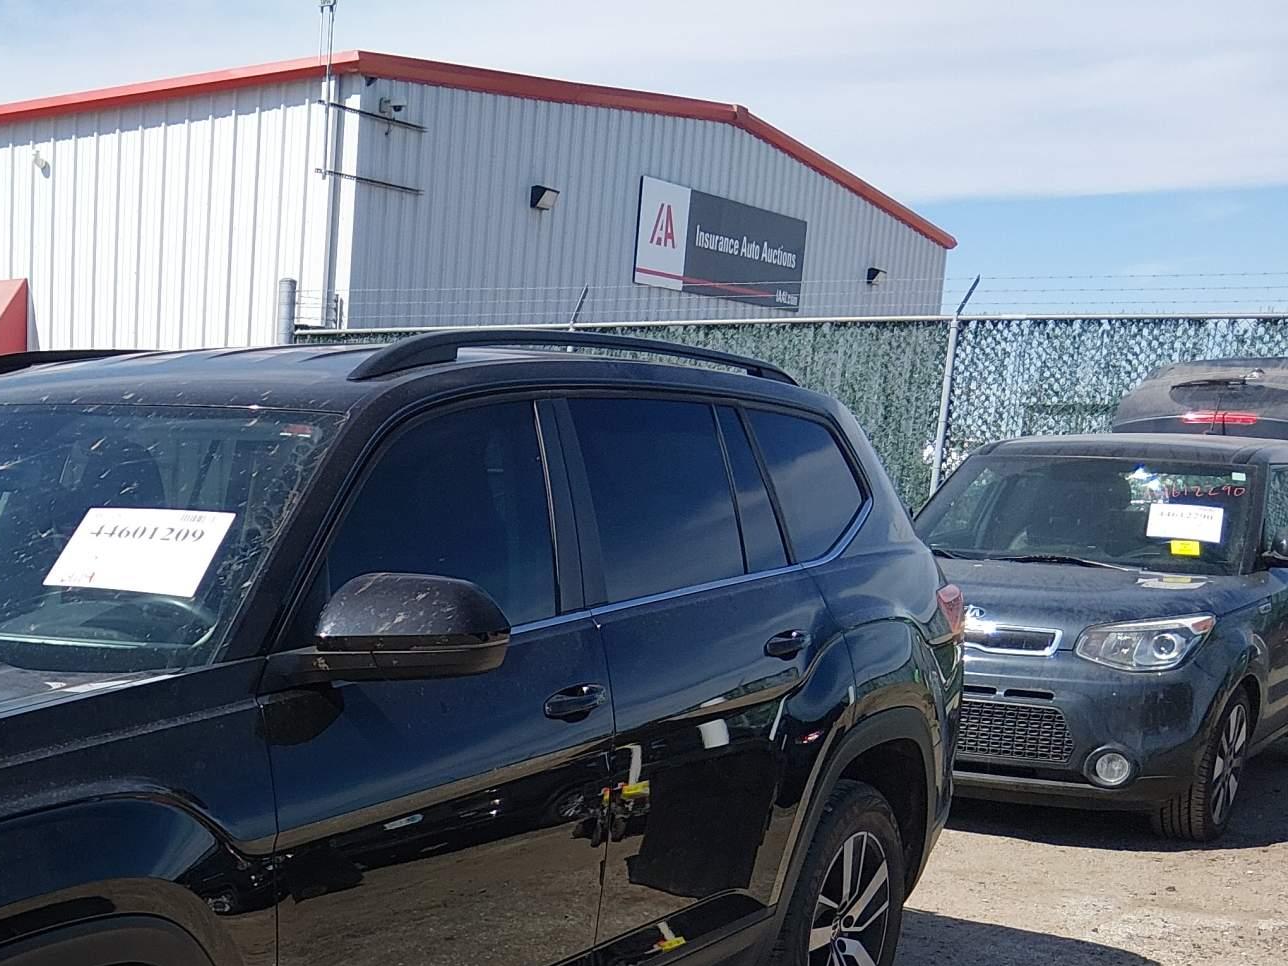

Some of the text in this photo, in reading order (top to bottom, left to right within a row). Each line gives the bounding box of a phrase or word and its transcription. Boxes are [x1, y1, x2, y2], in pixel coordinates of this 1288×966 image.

[695, 224, 797, 269] Insurance Auto Auctions
[90, 523, 206, 543] 44601209
